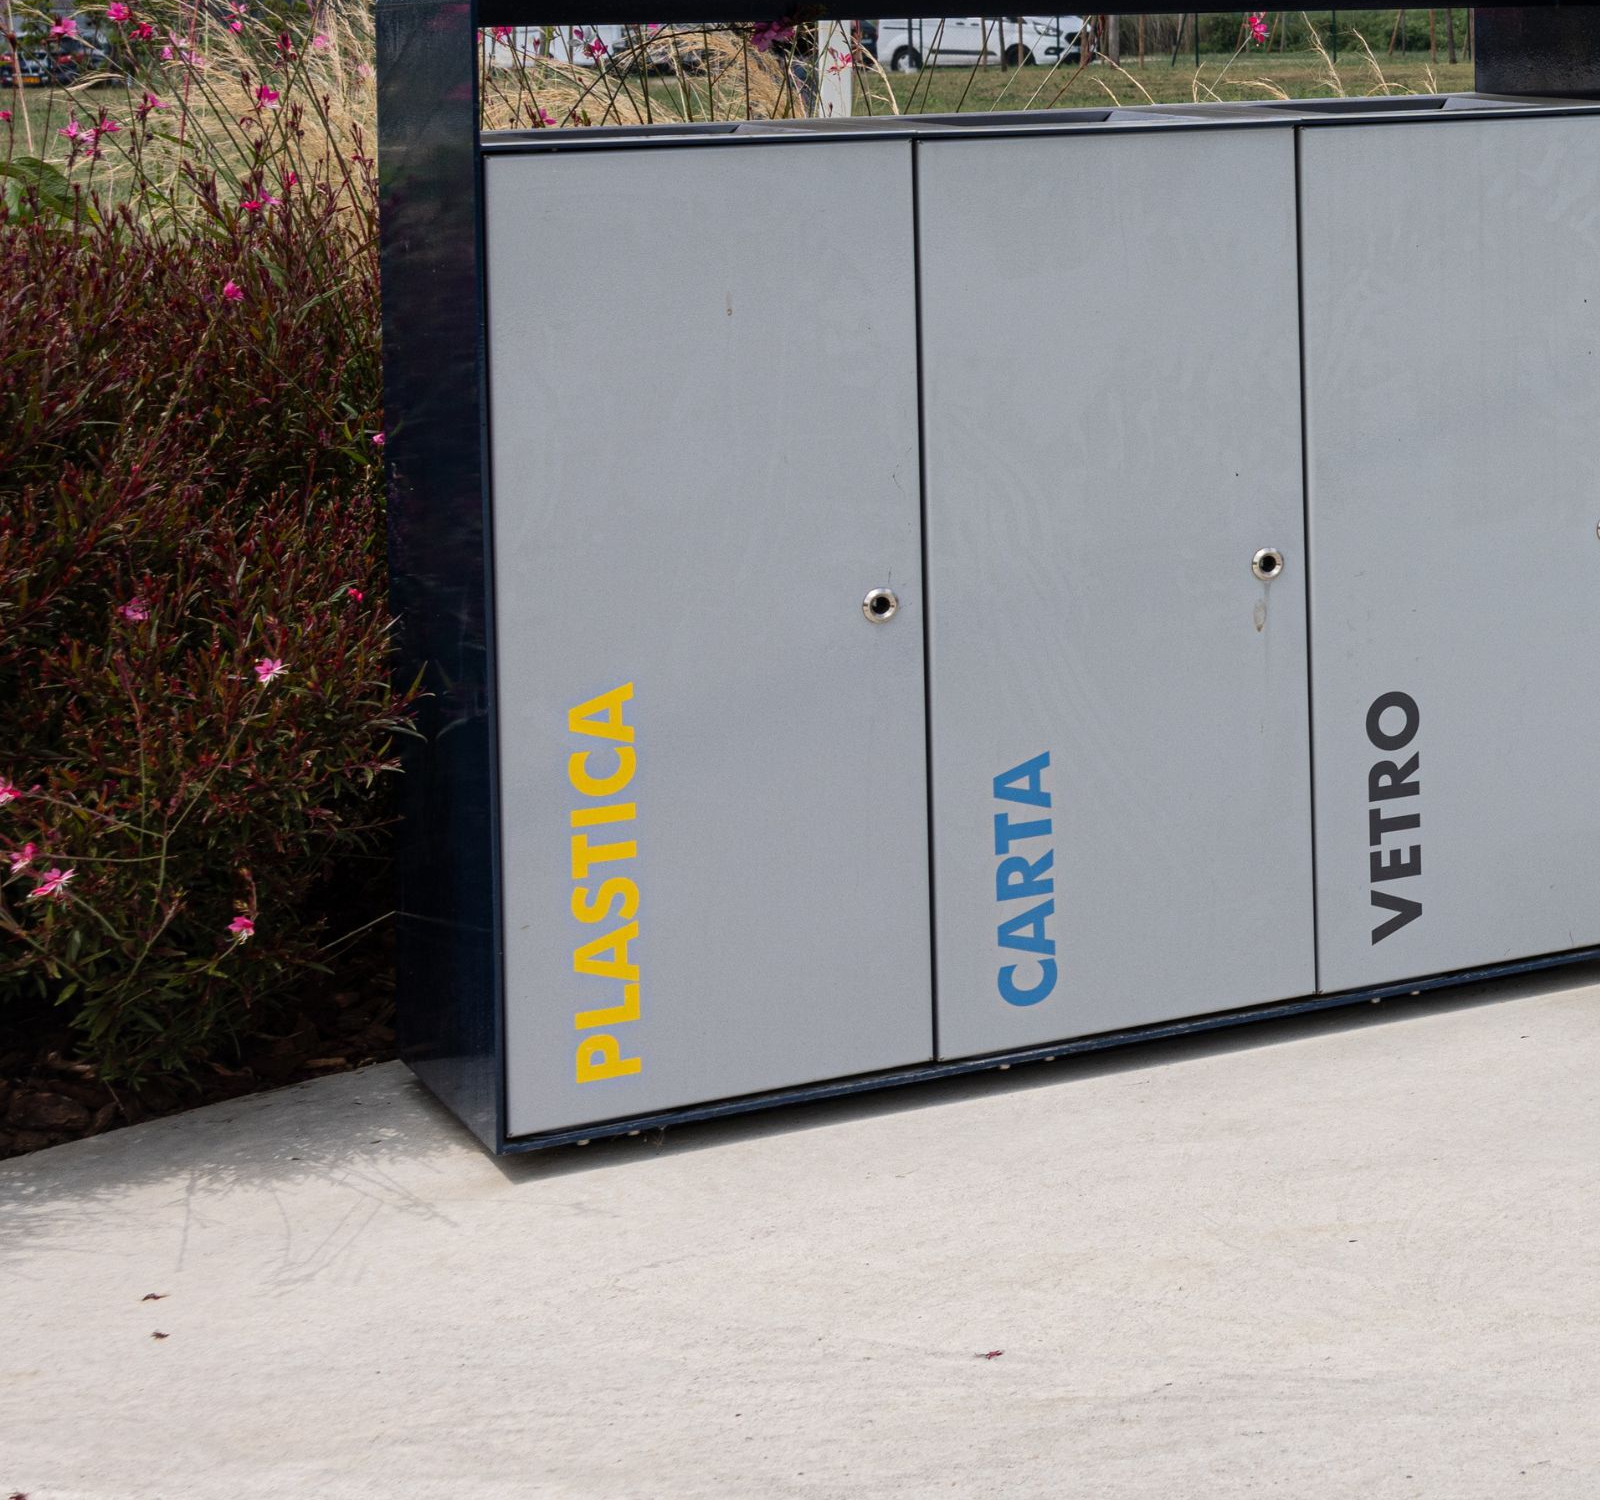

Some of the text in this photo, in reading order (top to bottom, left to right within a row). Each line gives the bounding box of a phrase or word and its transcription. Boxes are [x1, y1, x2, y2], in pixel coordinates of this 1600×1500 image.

[568, 681, 641, 1084] PLASTICA
[993, 750, 1058, 1007] CARTA
[1365, 690, 1423, 946] VETRO
